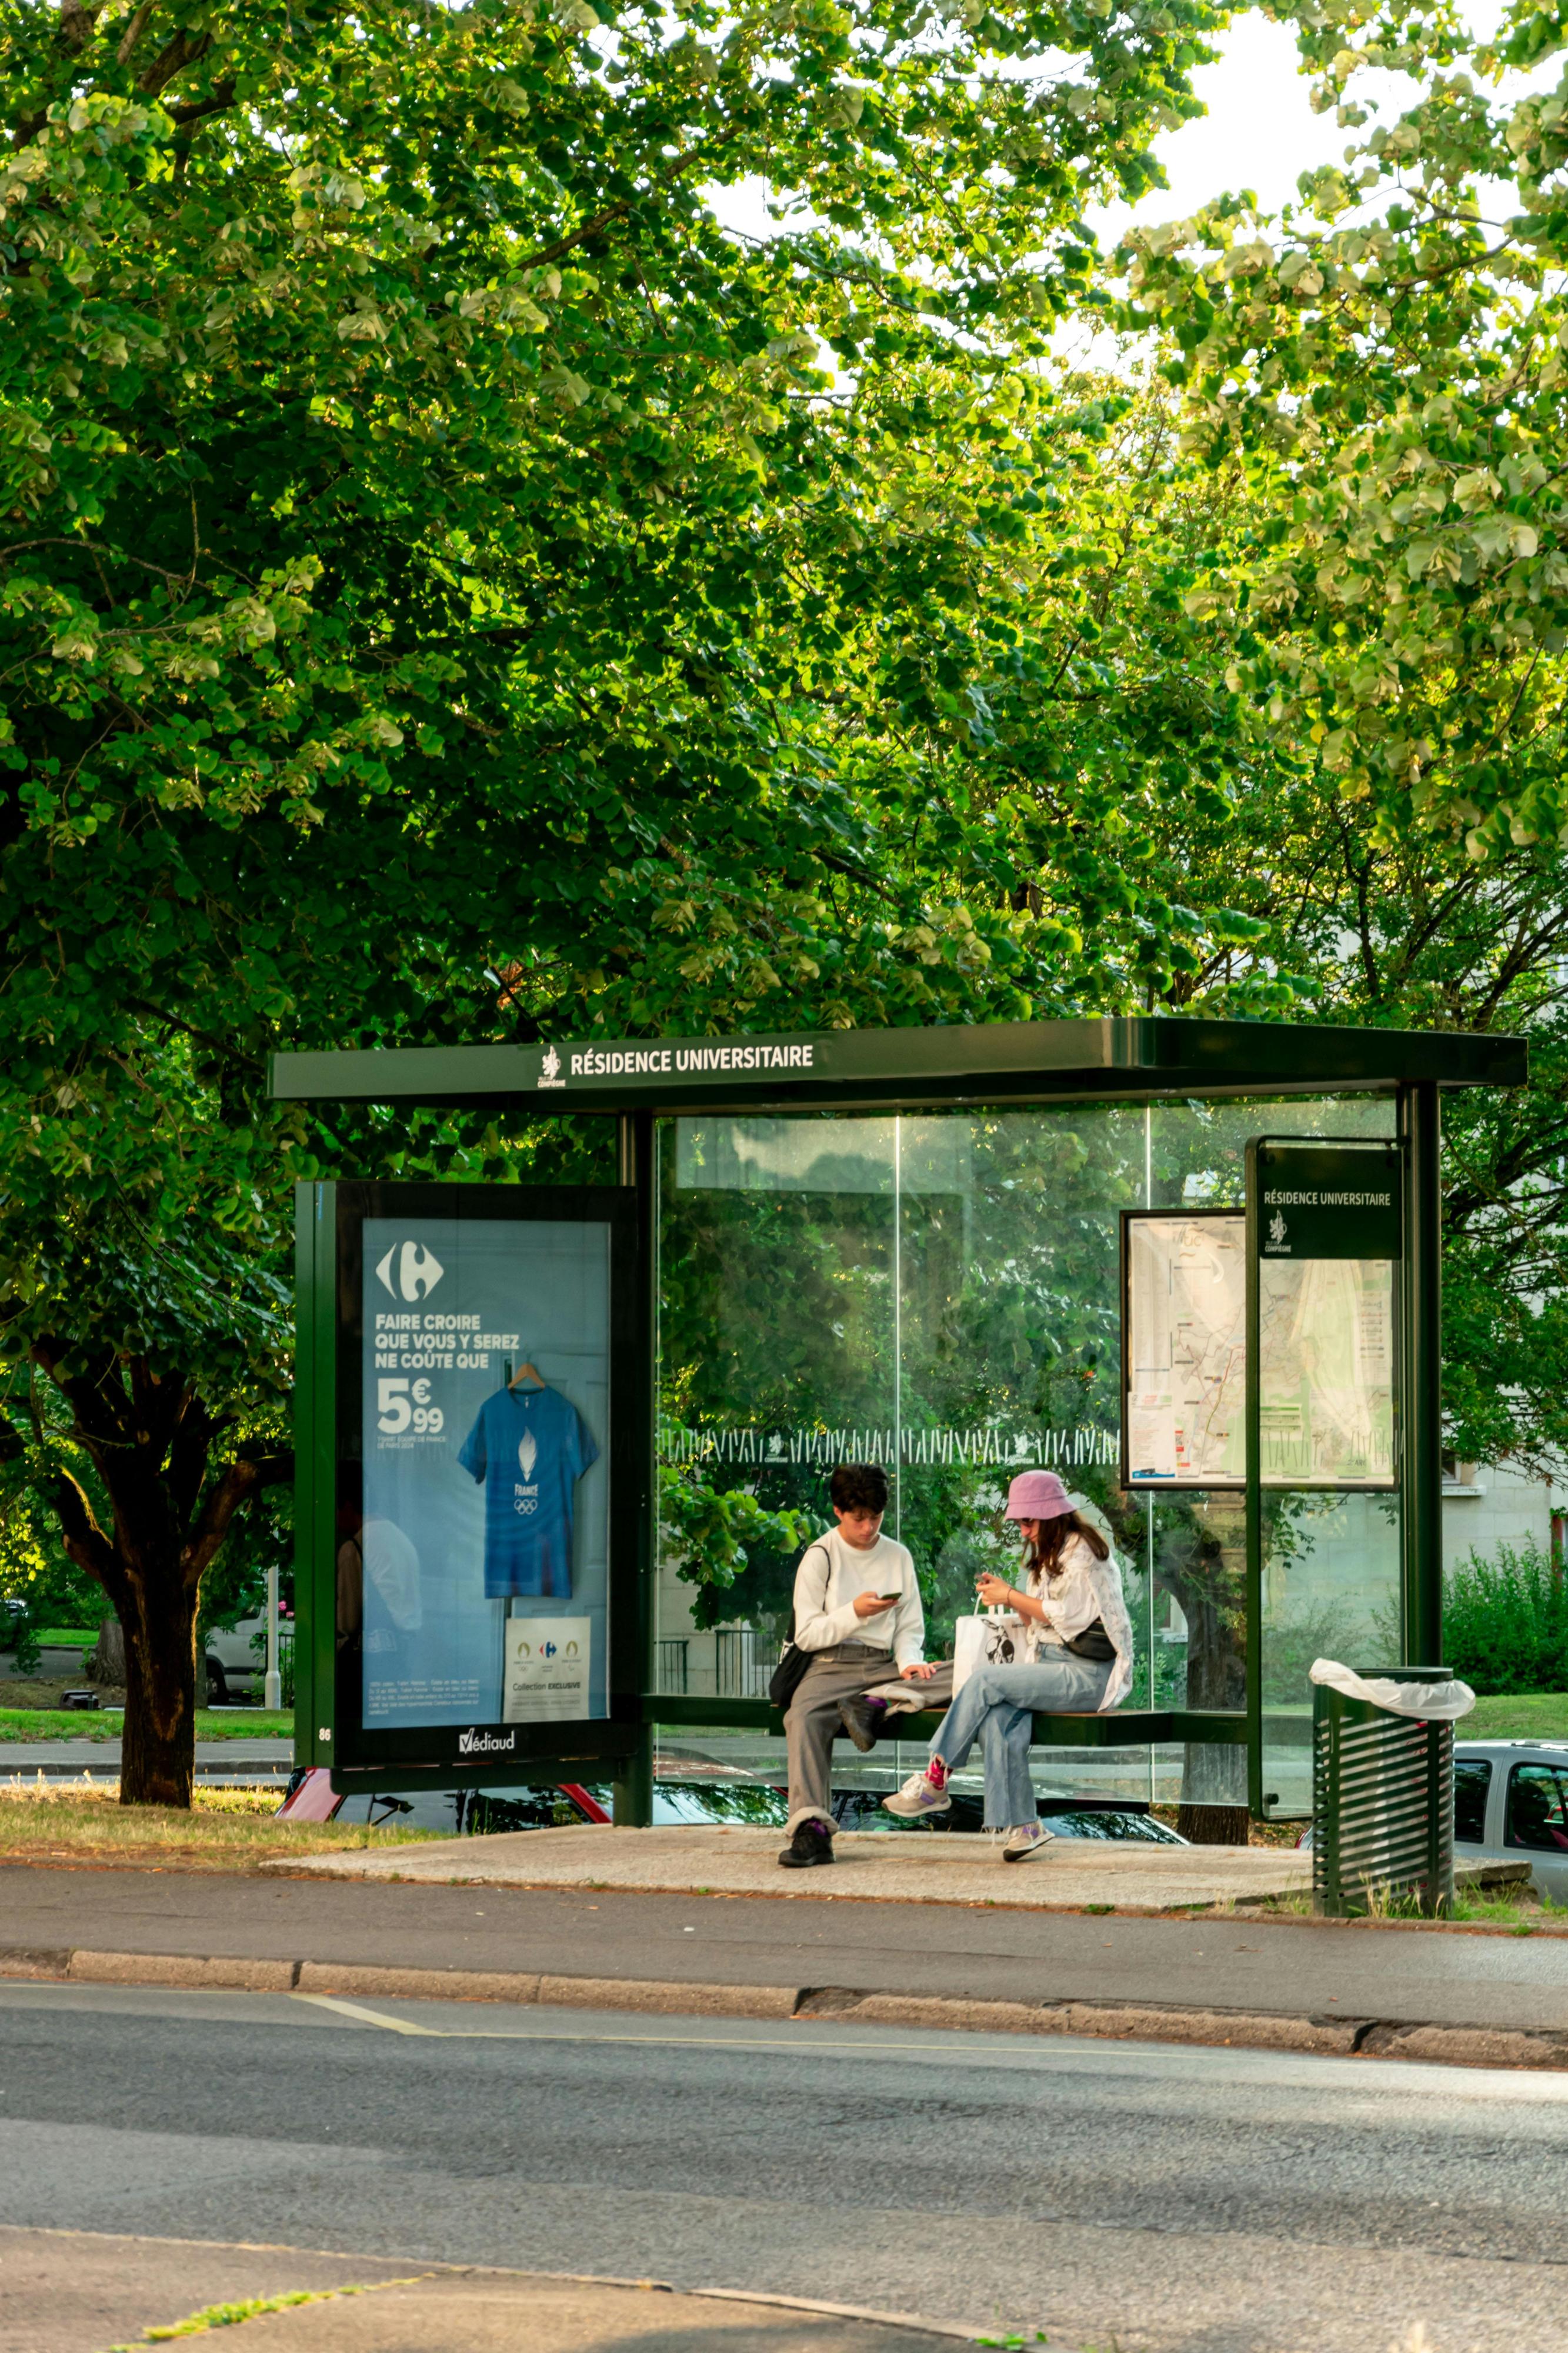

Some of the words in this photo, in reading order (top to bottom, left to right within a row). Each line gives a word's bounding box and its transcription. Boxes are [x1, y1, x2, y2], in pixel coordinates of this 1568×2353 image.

[571, 1048, 672, 1075] RÉSIDENCE
[676, 1045, 813, 1072] UNIVERSITAIRE
[1264, 1188, 1318, 1205] RÉSIDENCE
[1320, 1192, 1391, 1206] UNIVERSITAIRE
[376, 1314, 421, 1330] FAIRE
[423, 1314, 481, 1330] CROIRE
[375, 1334, 409, 1349] QUE
[413, 1334, 456, 1349] VOUS
[460, 1334, 470, 1349] Y
[473, 1334, 519, 1349] SEREZ
[375, 1353, 397, 1369] NE
[401, 1349, 453, 1369] COÛTE
[456, 1353, 489, 1369] QUE
[515, 1484, 539, 1497] FRANCE
[512, 1682, 546, 1691] Collection
[548, 1682, 581, 1690] EXCLUSIVE
[319, 1727, 331, 1741] 86
[459, 1727, 515, 1754] Védiaud
